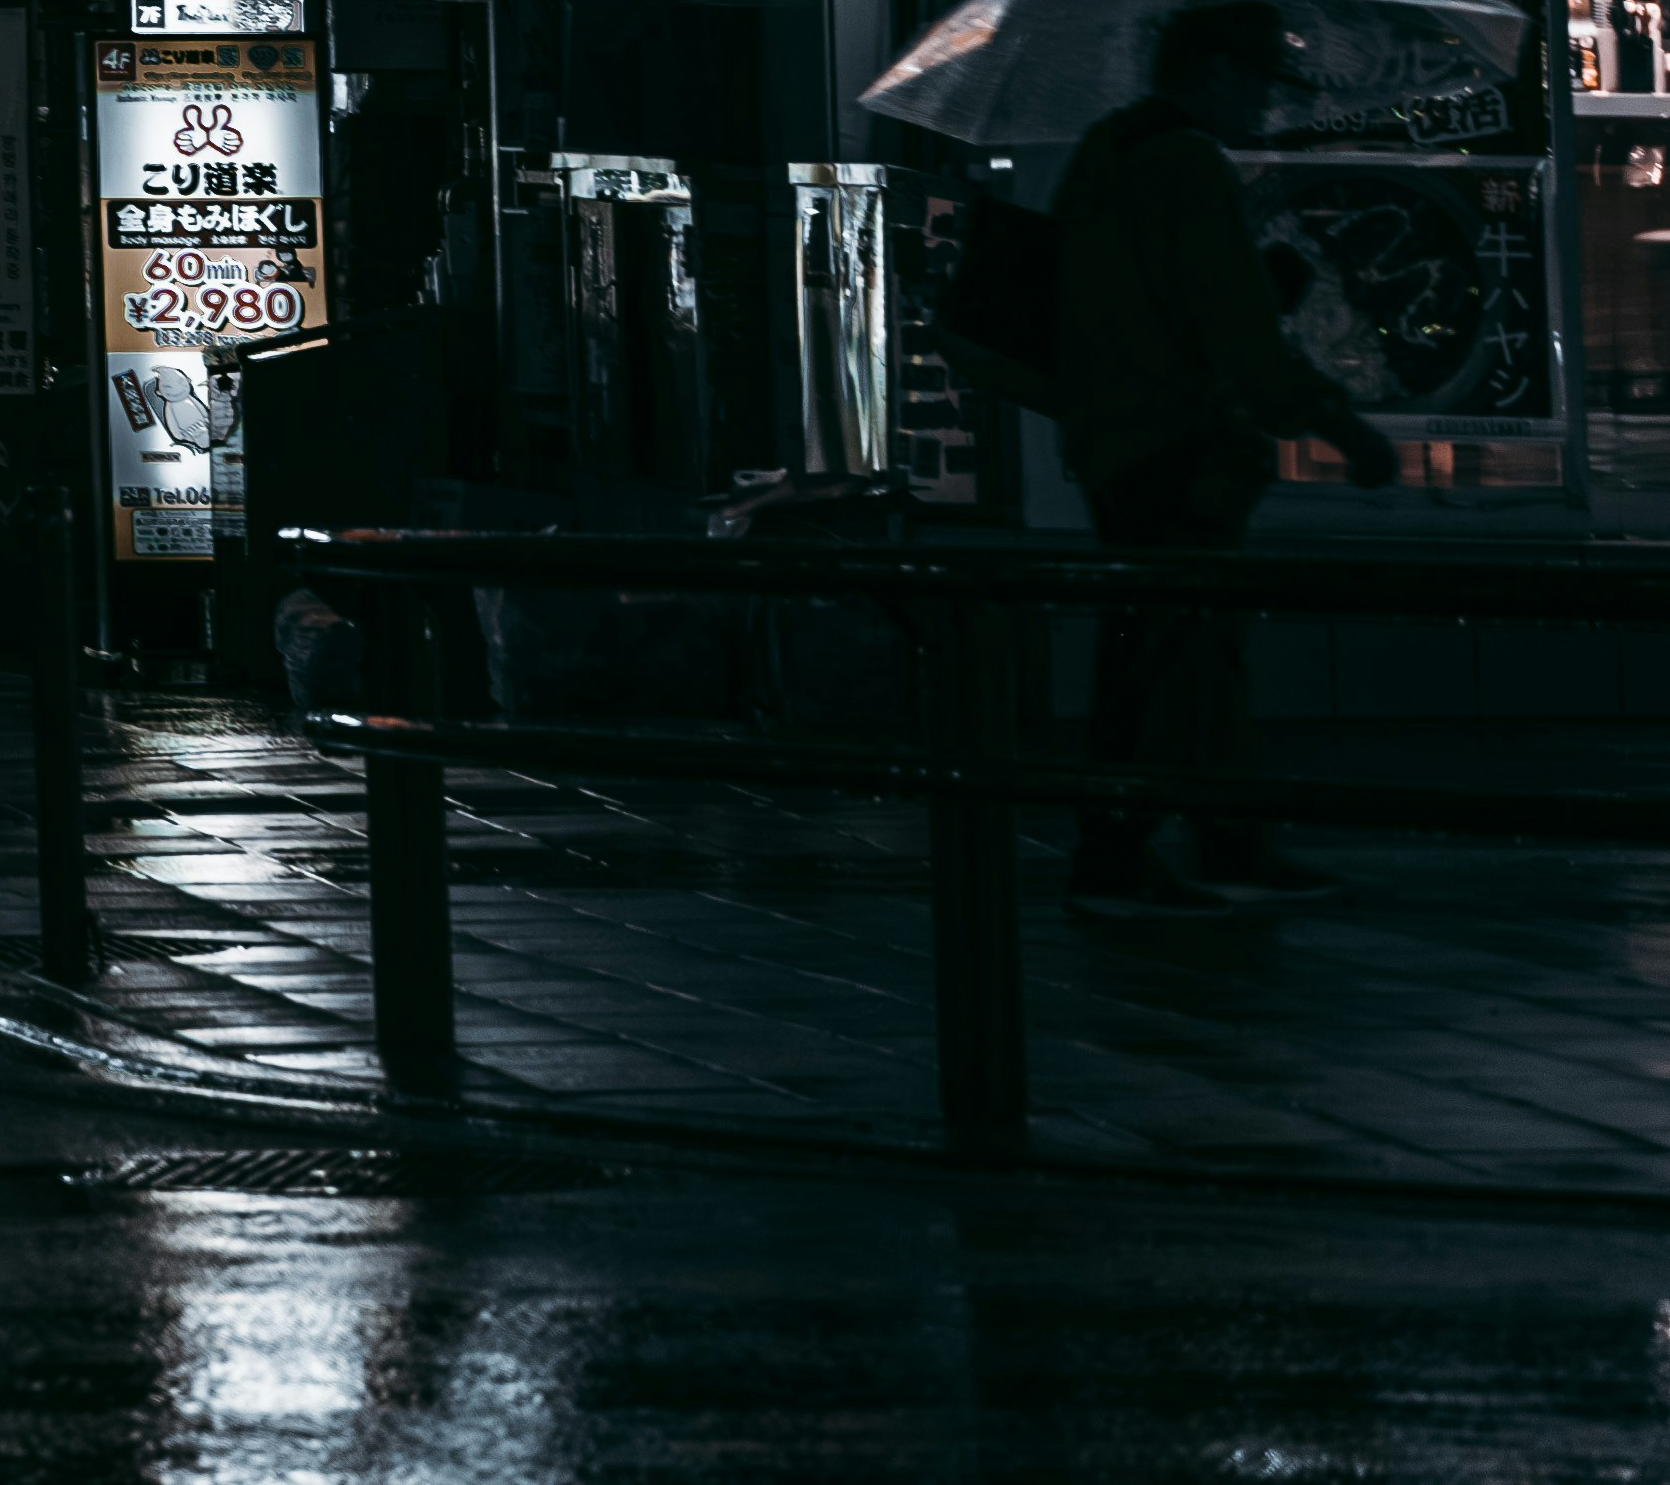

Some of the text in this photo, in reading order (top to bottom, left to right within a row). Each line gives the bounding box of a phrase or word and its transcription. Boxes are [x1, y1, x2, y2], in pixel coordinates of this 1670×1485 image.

[101, 48, 131, 70] 4F
[143, 162, 280, 196] こり道楽
[116, 202, 309, 233] 全身もみほぐし
[128, 288, 297, 328] ¥2,980
[1474, 220, 1533, 409] 牛ハヤシ
